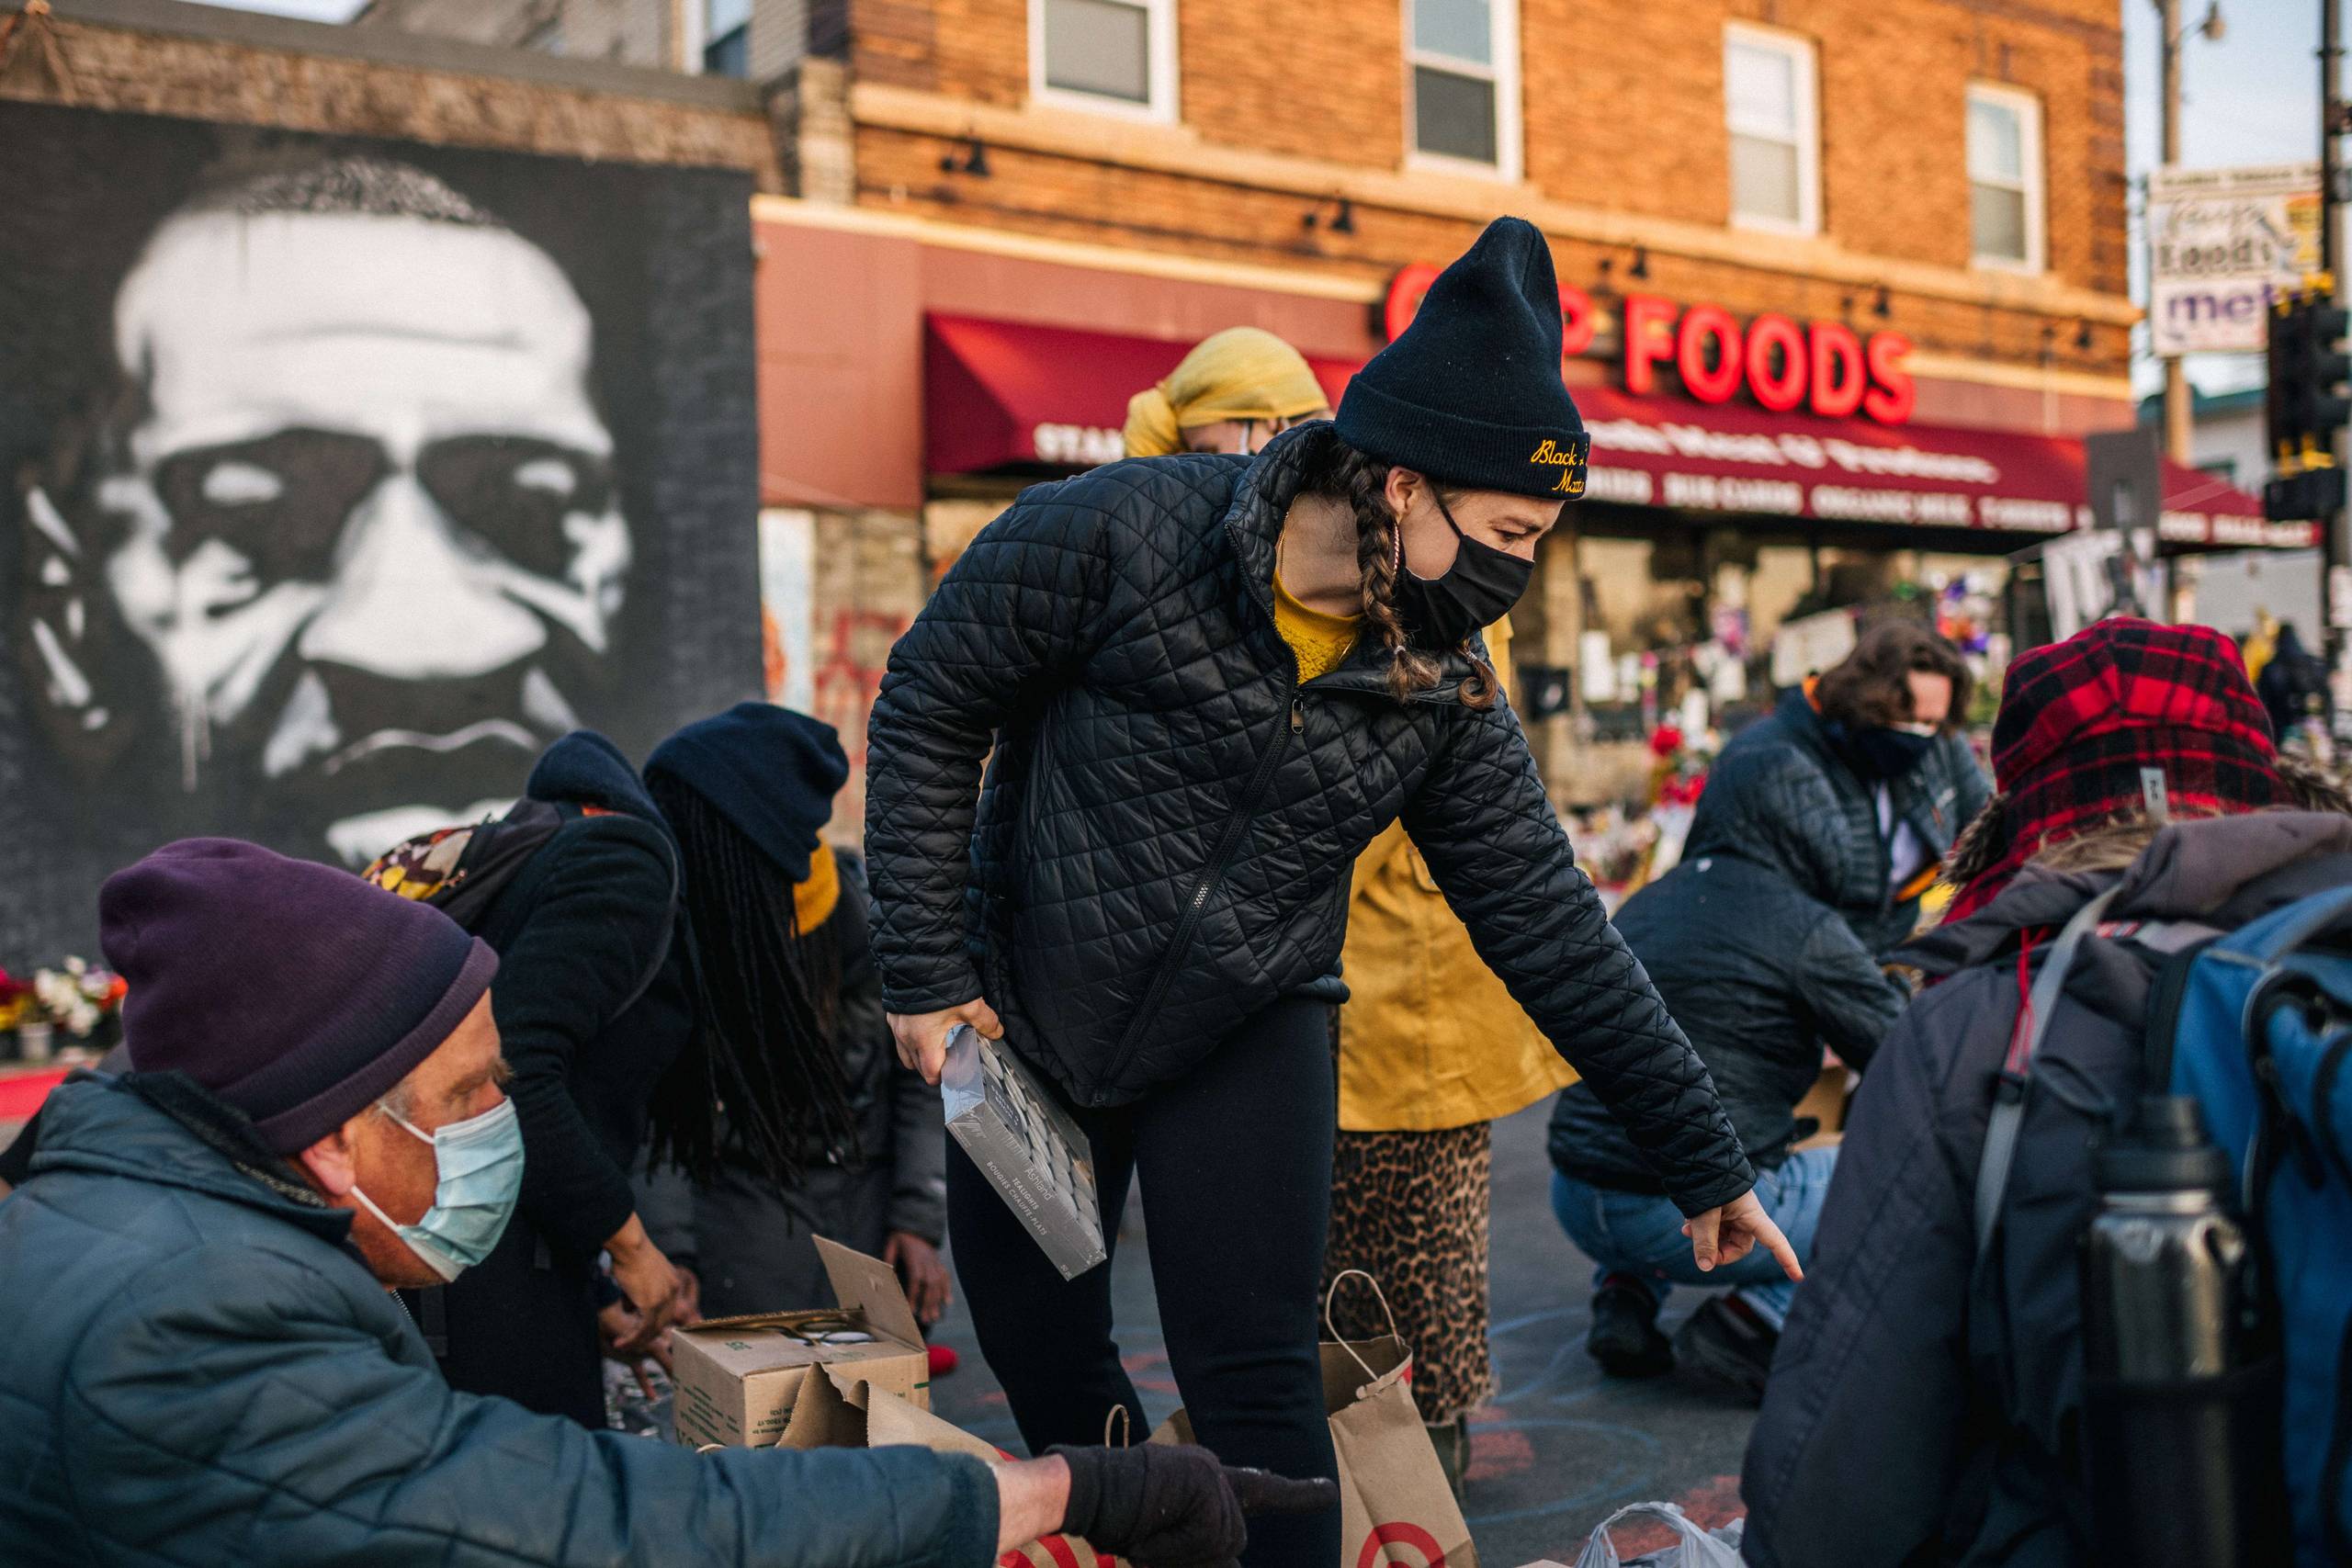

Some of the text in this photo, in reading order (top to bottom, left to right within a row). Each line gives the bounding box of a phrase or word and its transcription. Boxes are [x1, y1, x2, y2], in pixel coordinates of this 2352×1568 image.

[1624, 294, 1916, 424] FOODS
[1531, 439, 1577, 467] Black
[986, 1160, 1011, 1190] BOUGIES
[1024, 1168, 1054, 1201] Ashland
[1012, 1177, 1039, 1211] TEALIGHTS
